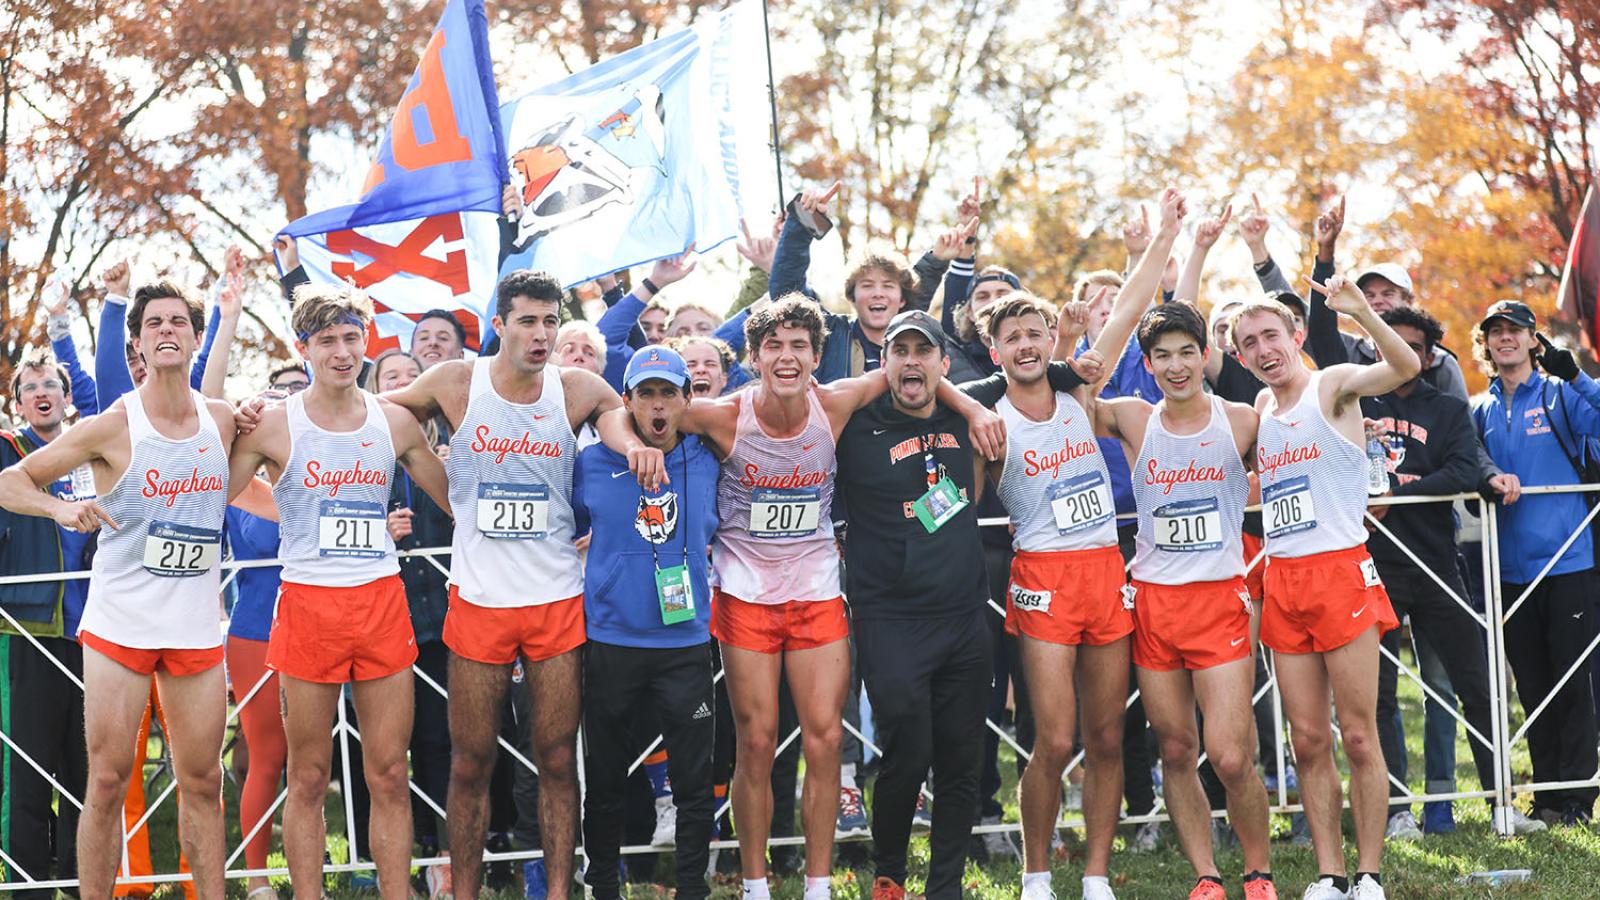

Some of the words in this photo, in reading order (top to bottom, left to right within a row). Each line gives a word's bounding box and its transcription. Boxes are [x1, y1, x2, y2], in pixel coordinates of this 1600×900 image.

[470, 424, 561, 465] Sagehens
[1024, 439, 1096, 479] Sagehens
[1257, 441, 1322, 480] Sagehens
[142, 468, 223, 507] Sagehens
[303, 460, 387, 497] Sagehens
[740, 464, 829, 489] Sagehens
[1145, 459, 1226, 495] Sagehens
[493, 502, 534, 530] 213
[766, 504, 806, 530] 207
[1067, 490, 1102, 523] 209
[1272, 495, 1302, 529] 206
[335, 519, 372, 548] 211
[1168, 515, 1207, 544] 210
[159, 541, 203, 569] 212
[1014, 588, 1042, 607] 209
